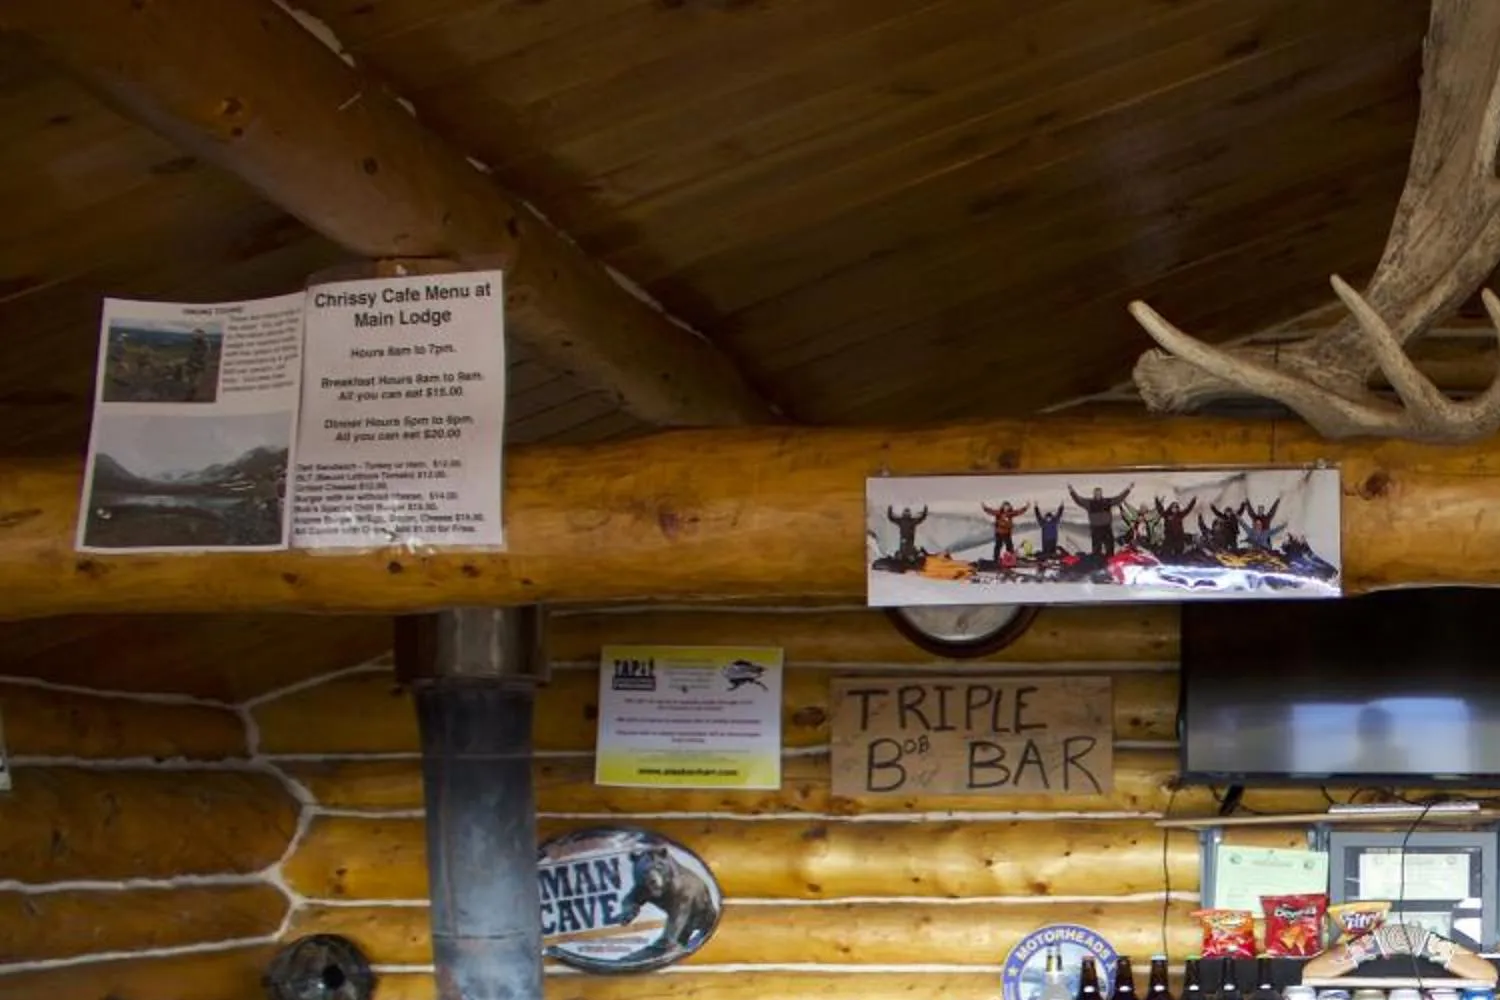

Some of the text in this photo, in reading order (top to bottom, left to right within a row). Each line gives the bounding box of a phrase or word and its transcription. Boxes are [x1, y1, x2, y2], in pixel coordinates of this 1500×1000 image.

[315, 282, 491, 308] Chrissy Cafe Menu at
[355, 308, 452, 328] Main Lodge
[351, 346, 385, 358] Hours
[414, 344, 426, 355] to
[321, 376, 375, 389] Breakfast
[379, 374, 413, 386] Hours
[443, 372, 455, 382] to
[356, 390, 379, 403] you
[382, 389, 402, 399] can
[405, 388, 423, 398] eat
[365, 416, 400, 428] Hours
[354, 431, 375, 443] you
[378, 430, 399, 440] can
[402, 429, 420, 439] eat
[847, 684, 1048, 734] TRIPLE
[966, 735, 1103, 796] BAR
[538, 855, 622, 900] MAN
[540, 892, 625, 935] CAVE
[1015, 927, 1111, 961] MOTORHEADS
